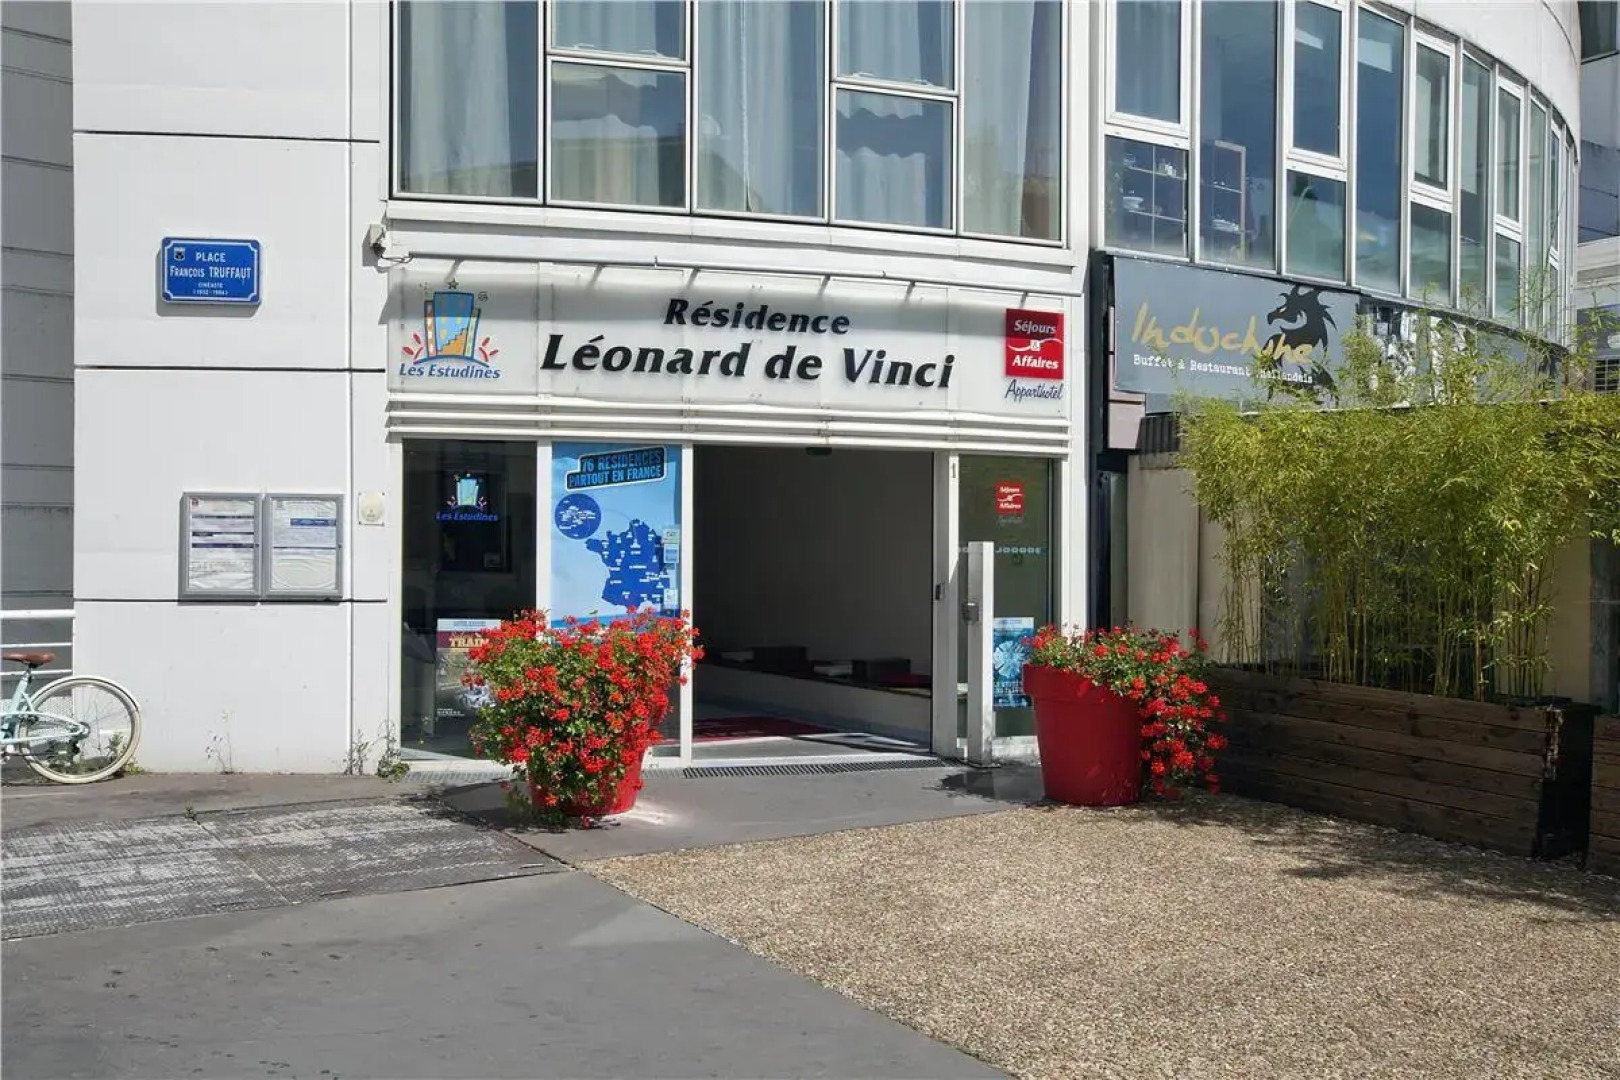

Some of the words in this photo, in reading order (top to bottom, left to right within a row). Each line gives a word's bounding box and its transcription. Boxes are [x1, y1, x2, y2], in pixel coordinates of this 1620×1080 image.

[195, 251, 226, 262] PLACE
[209, 266, 252, 279] TRUFFAUT
[663, 297, 851, 335] Résidence
[1014, 319, 1057, 335] Séjours
[1130, 301, 1314, 364] Indochine
[399, 363, 425, 376] Les
[428, 365, 500, 379] Estudines
[540, 333, 753, 378] Léonard
[764, 345, 823, 382] de
[842, 347, 956, 390] Vinci
[1012, 354, 1060, 370] Affaires
[1133, 353, 1174, 369] Buffet
[1178, 359, 1185, 370] &
[1190, 359, 1251, 377] Restaurant
[569, 470, 610, 487] PARTOUT
[612, 470, 625, 482] EN
[627, 465, 662, 480] FRANCE
